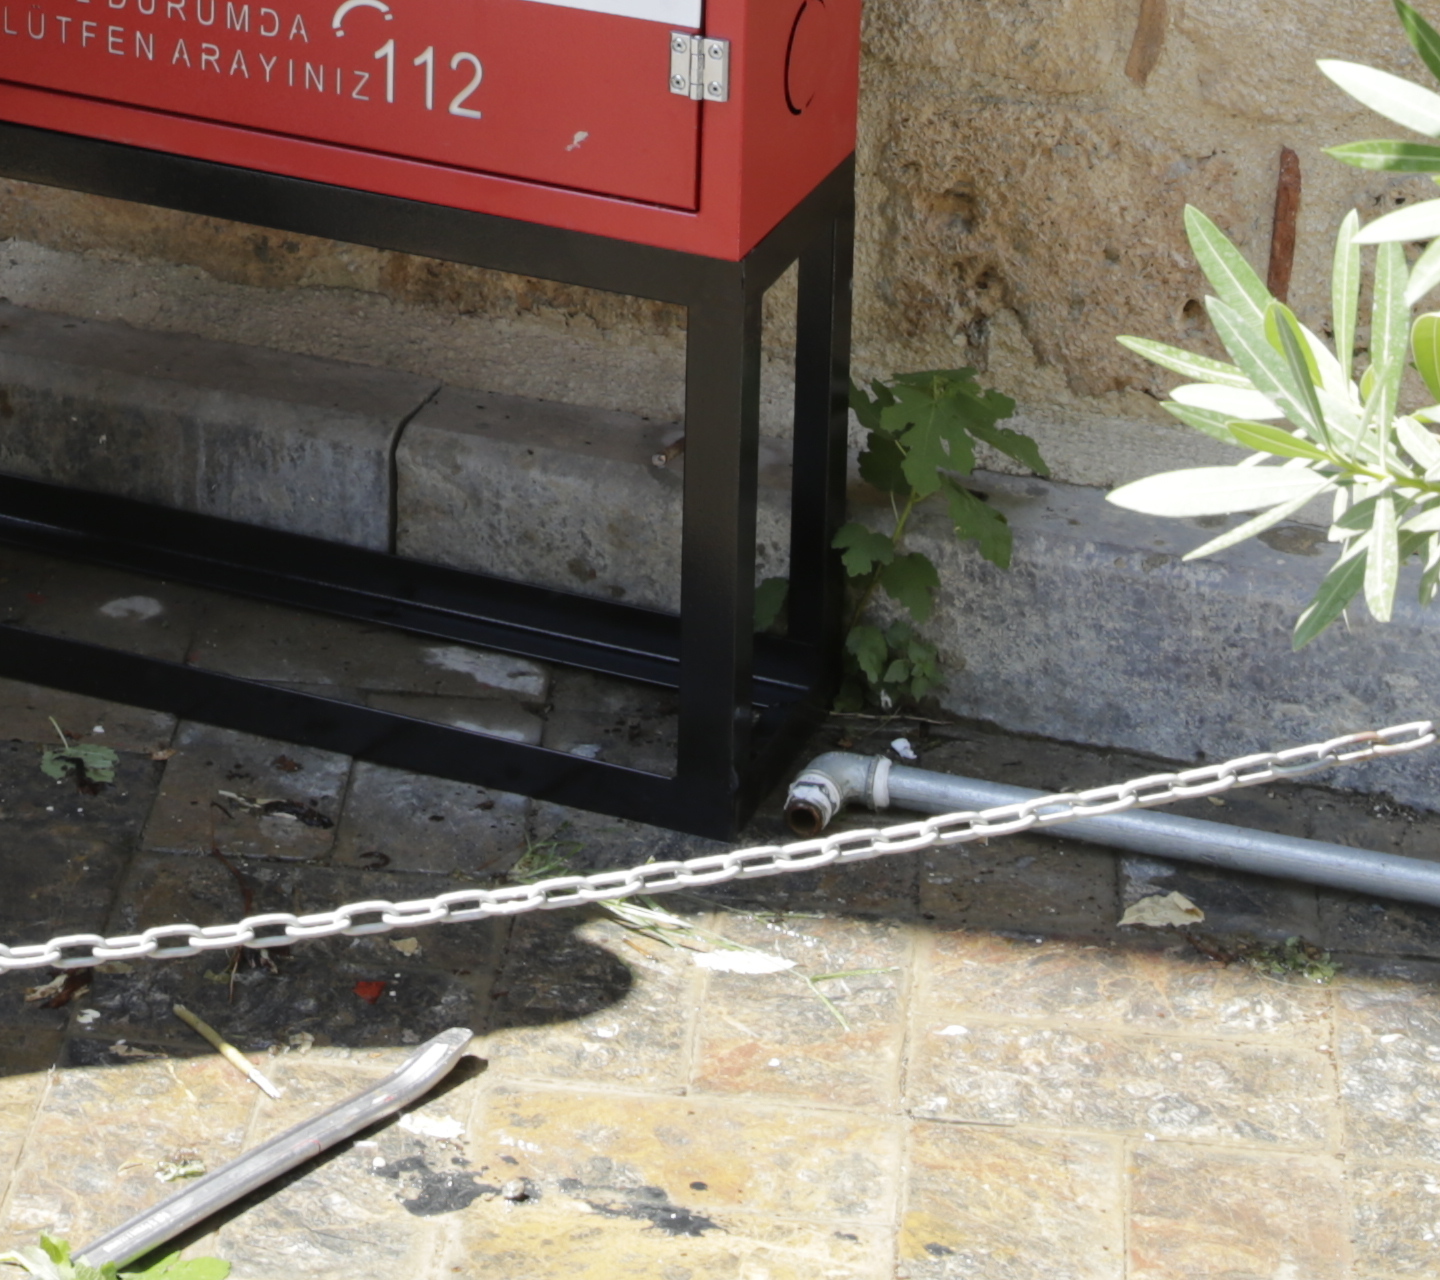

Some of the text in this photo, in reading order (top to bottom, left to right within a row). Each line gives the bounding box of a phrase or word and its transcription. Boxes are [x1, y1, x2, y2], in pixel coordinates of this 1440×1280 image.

[2, 4, 370, 101] LÜTFEN ARAYINIZ
[373, 38, 484, 120] 112
